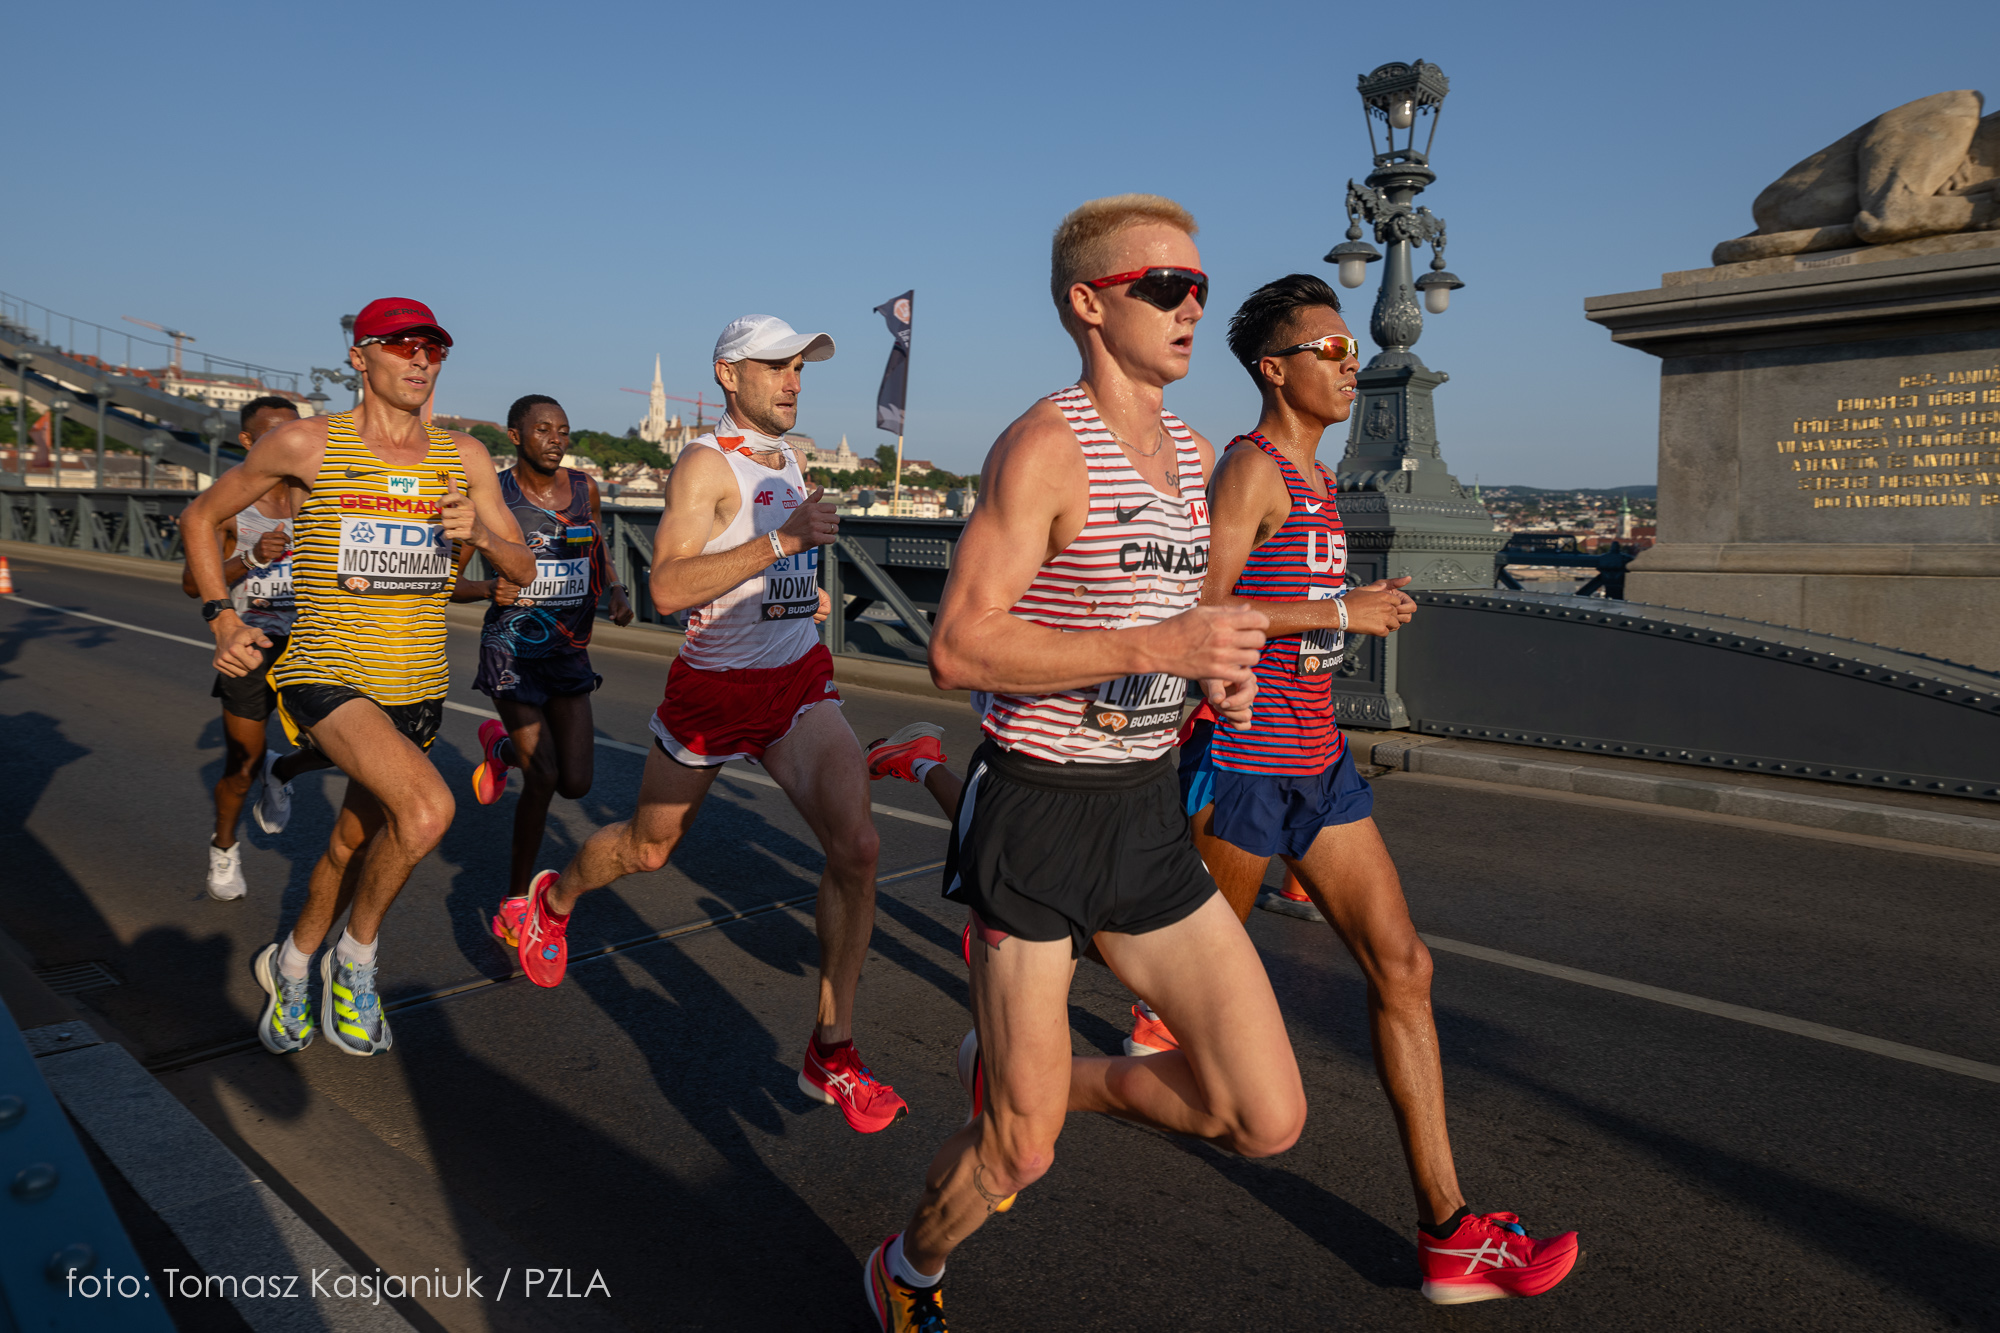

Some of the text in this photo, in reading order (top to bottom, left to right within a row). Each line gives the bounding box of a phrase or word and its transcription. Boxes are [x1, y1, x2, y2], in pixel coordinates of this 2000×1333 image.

[1837, 394, 1919, 412] BUDAPEST
[1905, 409, 1953, 428] VILÁG
[754, 491, 773, 506] 4F
[376, 523, 446, 548] TDK
[343, 548, 448, 575] MOTSCHMANN
[537, 561, 584, 577] TDK
[252, 581, 266, 596] O.
[373, 581, 430, 590] BUDAPEST
[519, 579, 585, 596] MUHITIRA
[1129, 711, 1180, 729] BUDAPEST
